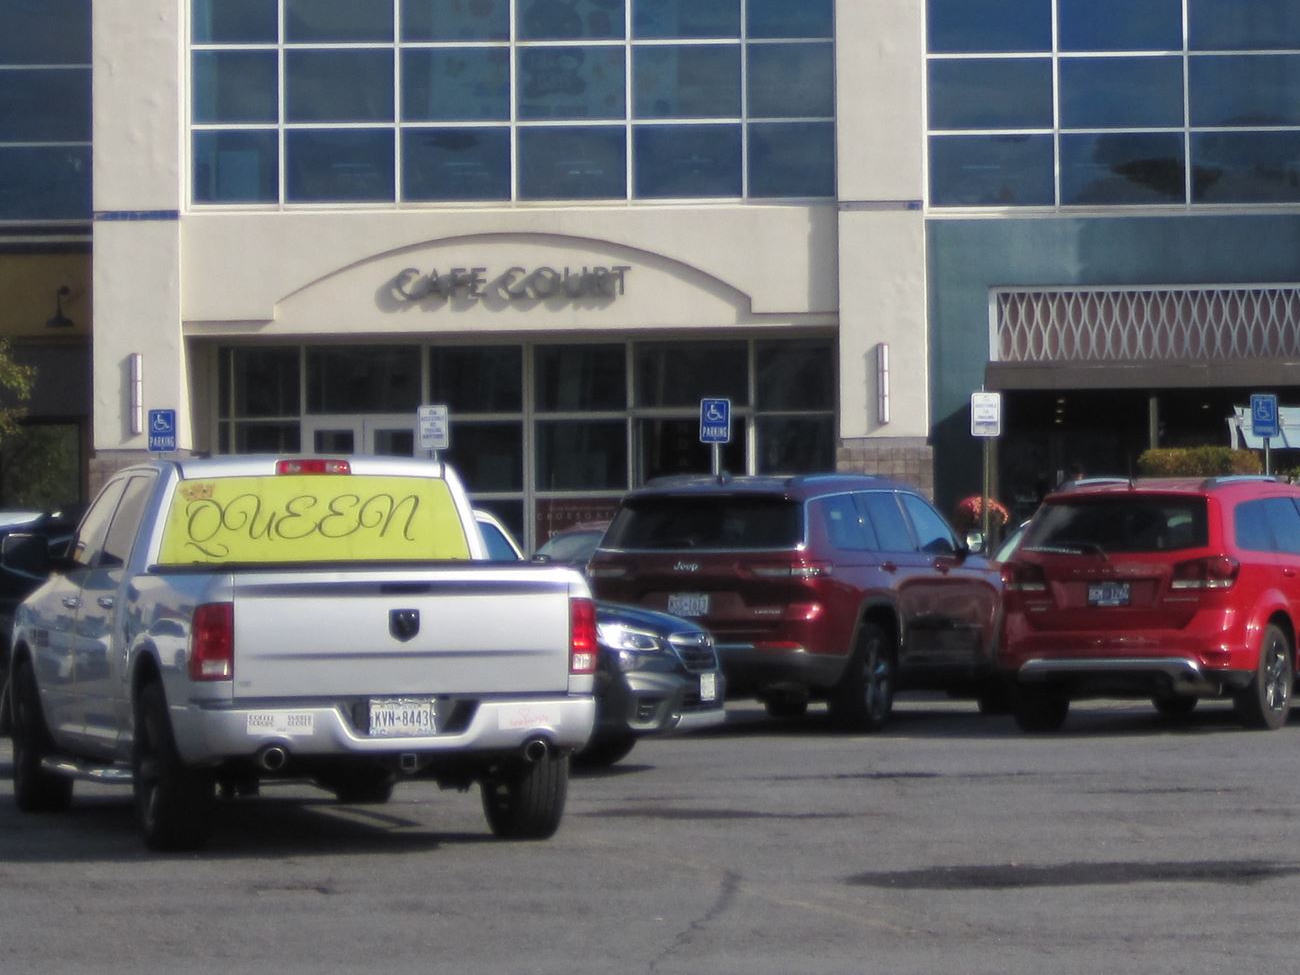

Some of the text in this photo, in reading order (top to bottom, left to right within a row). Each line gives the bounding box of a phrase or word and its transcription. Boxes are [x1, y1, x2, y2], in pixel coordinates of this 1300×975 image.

[395, 266, 632, 300] CAFE COURT
[702, 426, 728, 438] PARKING
[149, 436, 175, 447] PARKING
[673, 560, 699, 572] Jeep
[374, 710, 429, 727] KVN-8443
